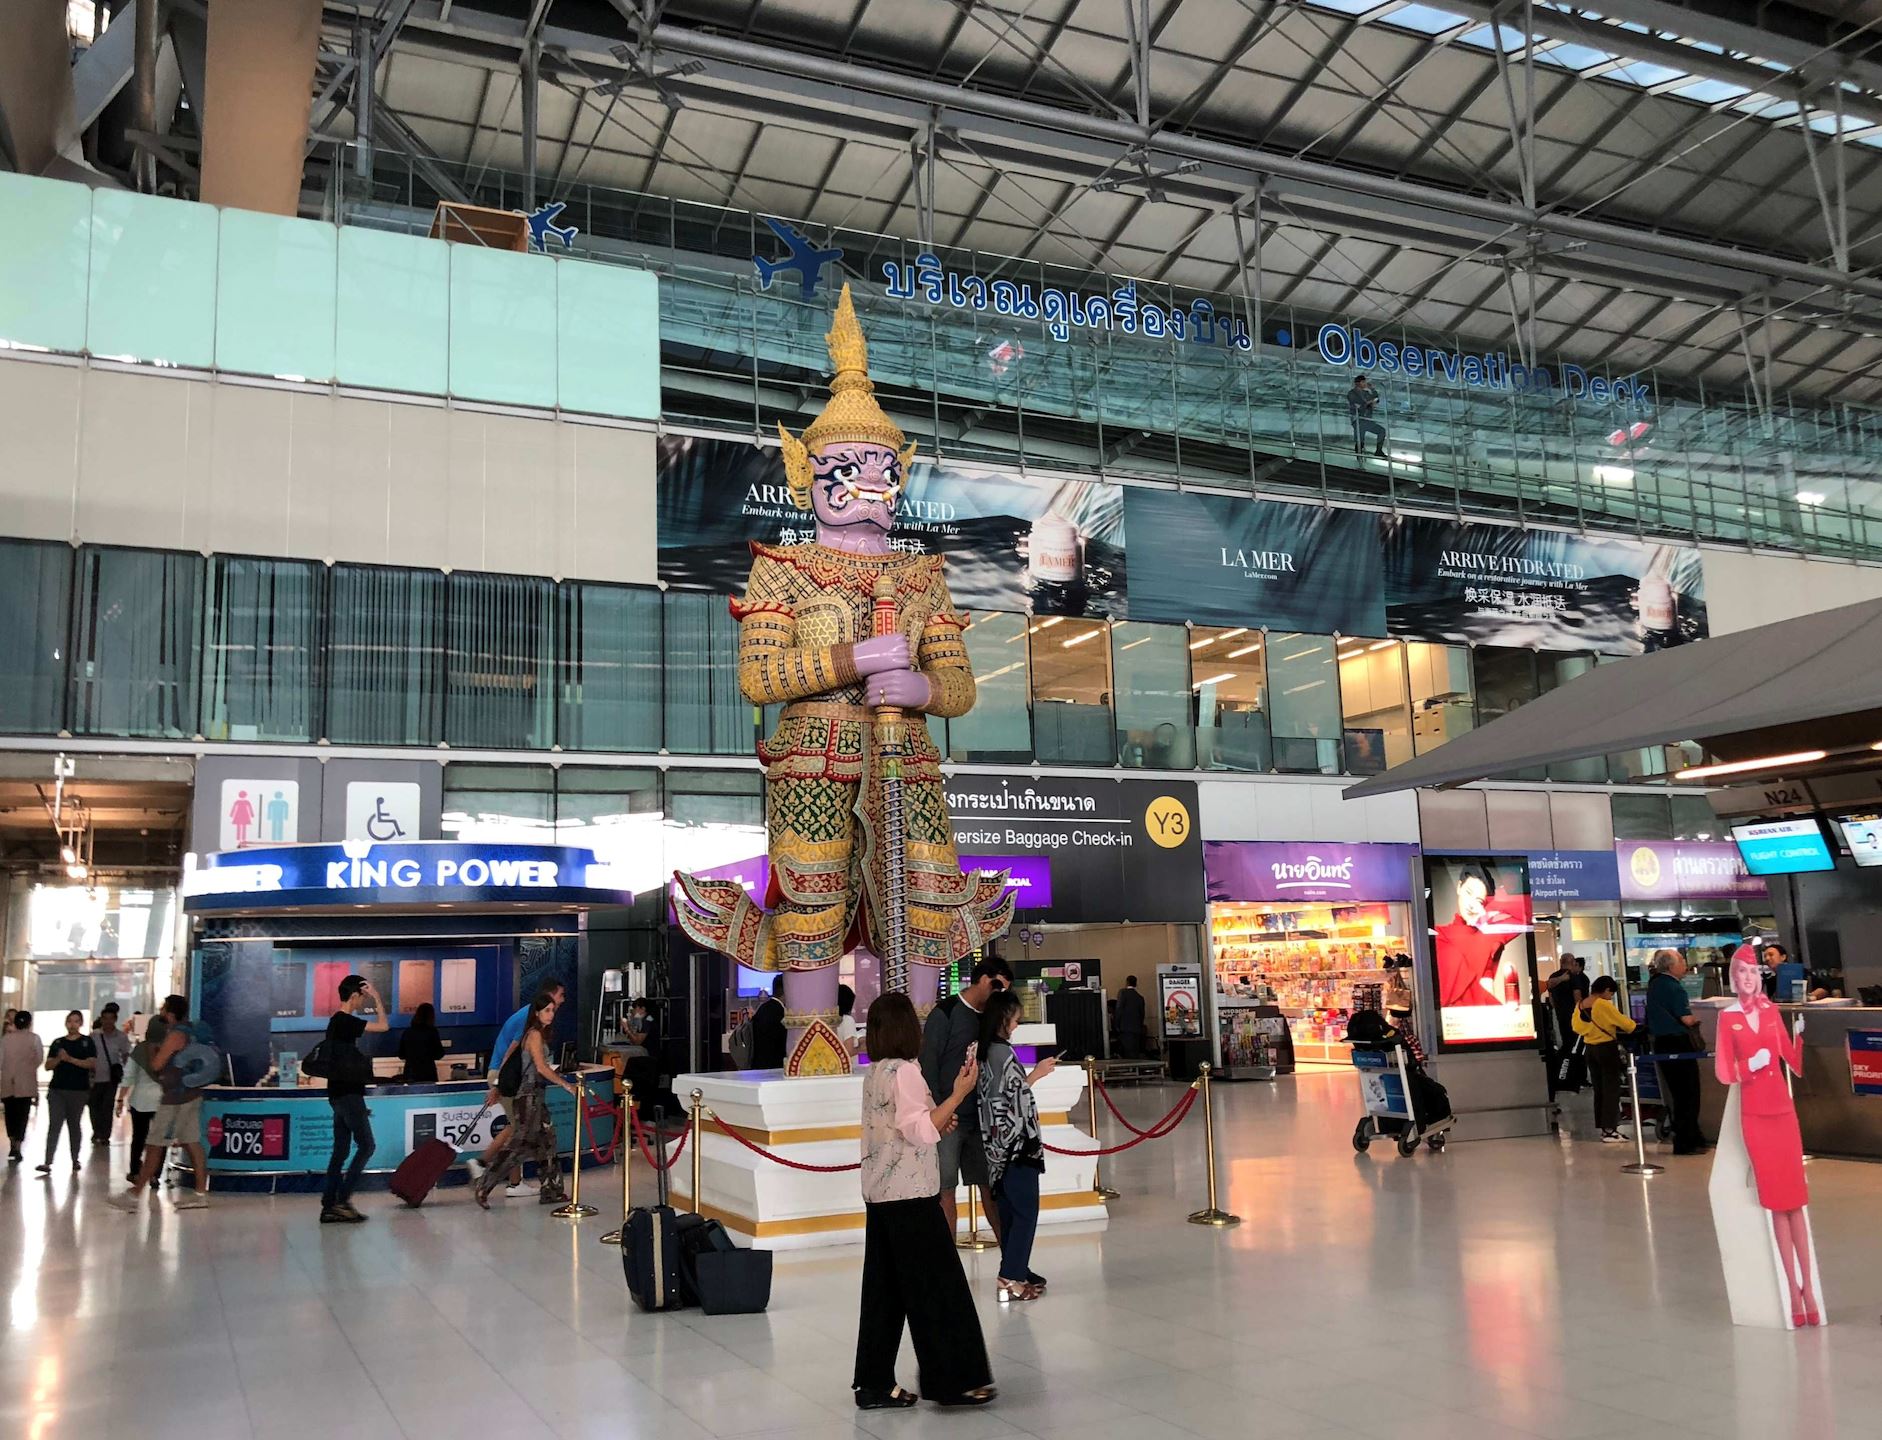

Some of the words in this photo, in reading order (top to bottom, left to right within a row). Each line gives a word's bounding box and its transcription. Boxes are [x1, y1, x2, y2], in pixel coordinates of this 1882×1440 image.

[882, 253, 1252, 350] บริเวณดูเครื่องบิน
[1318, 323, 1551, 394] Observation
[1562, 362, 1650, 411] Deck
[742, 504, 783, 518] Embark
[785, 511, 798, 520] on
[800, 512, 807, 520] a
[903, 522, 924, 532] with
[926, 522, 939, 533] La
[941, 524, 960, 535] Mer
[1221, 548, 1248, 568] LA
[1252, 550, 1296, 572] MER
[1439, 550, 1499, 571] ARRIVE
[1502, 556, 1584, 579] HYDRATED
[1438, 568, 1466, 579] Embark
[1484, 574, 1520, 584] restorative
[1521, 577, 1547, 588] journey
[1575, 582, 1588, 590] Mer
[1764, 788, 1802, 805] N24
[1153, 811, 1184, 835] Y3
[953, 829, 1001, 844] versize
[1005, 829, 1068, 849] Baggage
[1072, 830, 1133, 846] Check-in
[327, 856, 421, 888] KING
[437, 858, 558, 888] POWER
[1271, 855, 1354, 880] นายอินทร์
[1535, 889, 1557, 898] Airport
[1558, 889, 1579, 897] Permit
[224, 1132, 262, 1154] 10%
[443, 1124, 481, 1144] 5%
